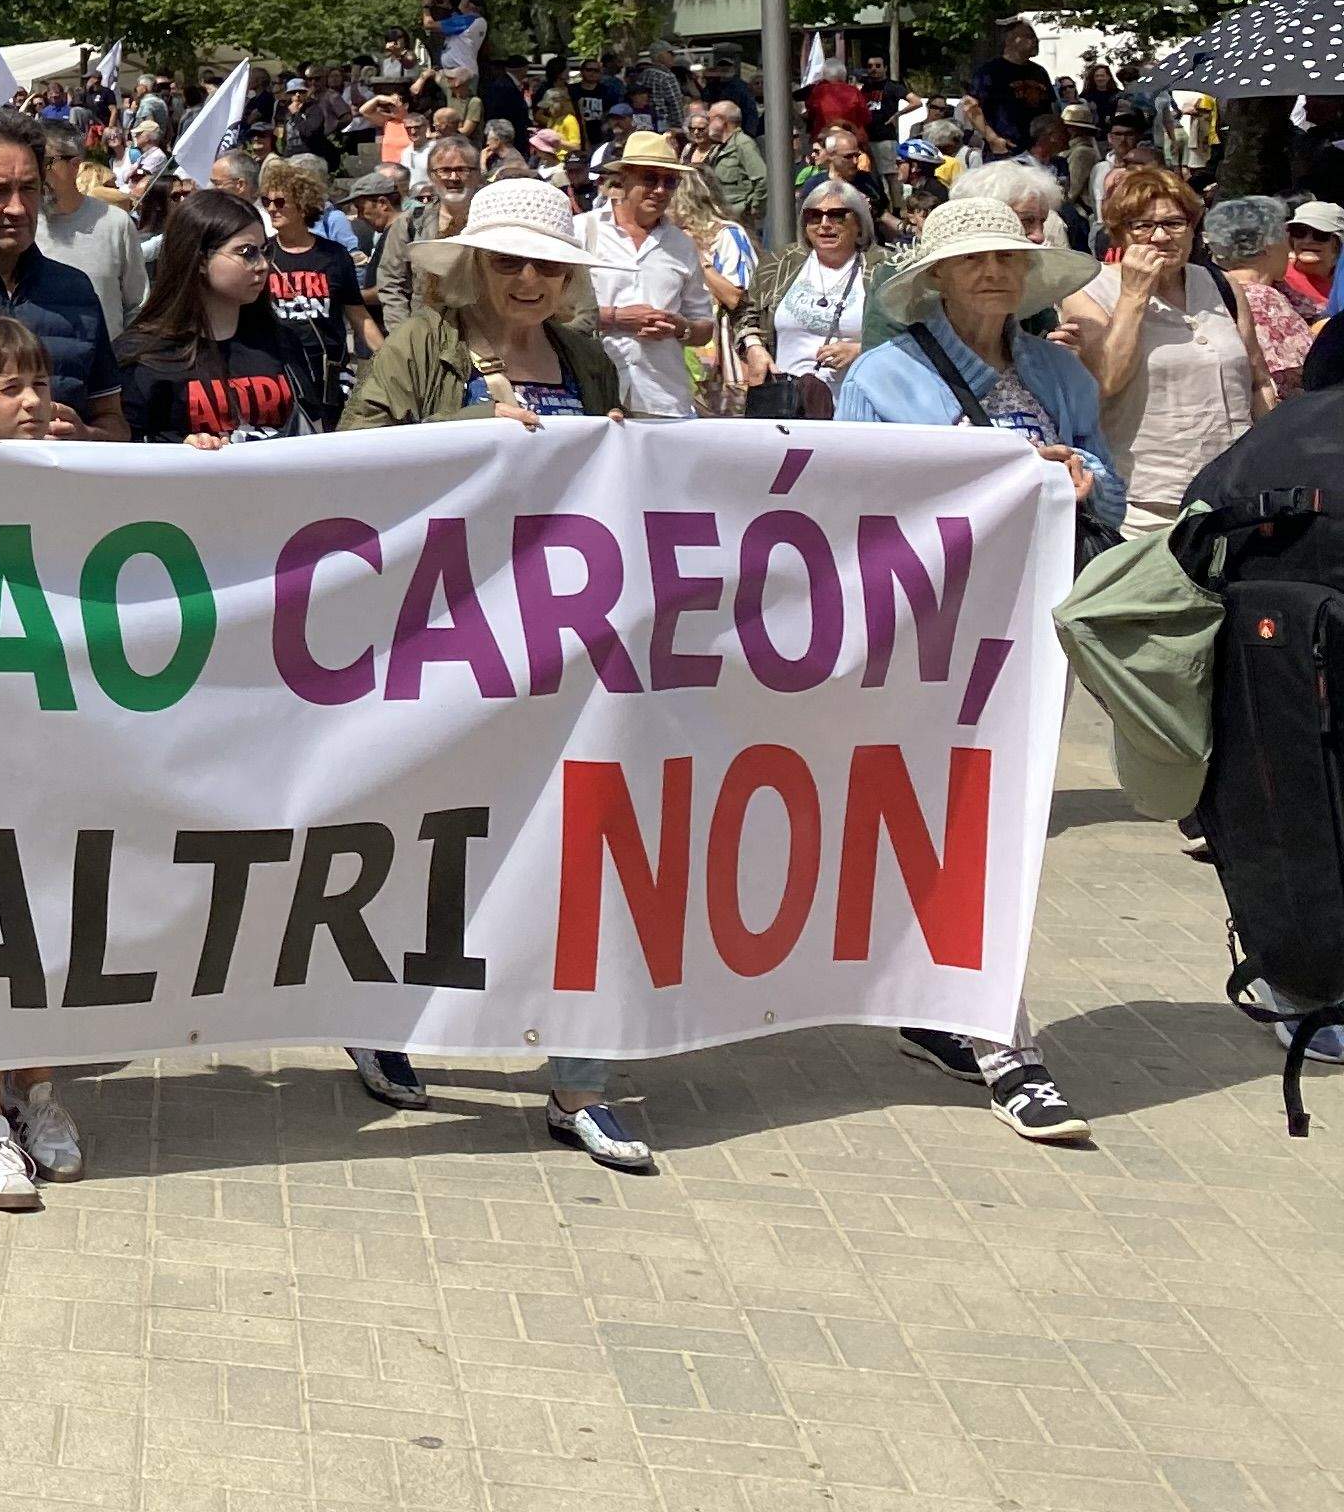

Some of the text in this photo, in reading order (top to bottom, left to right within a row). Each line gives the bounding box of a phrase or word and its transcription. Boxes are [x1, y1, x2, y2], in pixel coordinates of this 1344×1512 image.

[269, 271, 330, 299] ALTRI
[188, 373, 293, 433] ALTRI
[272, 448, 1015, 726] CAREÓN,
[552, 743, 993, 992] NON
